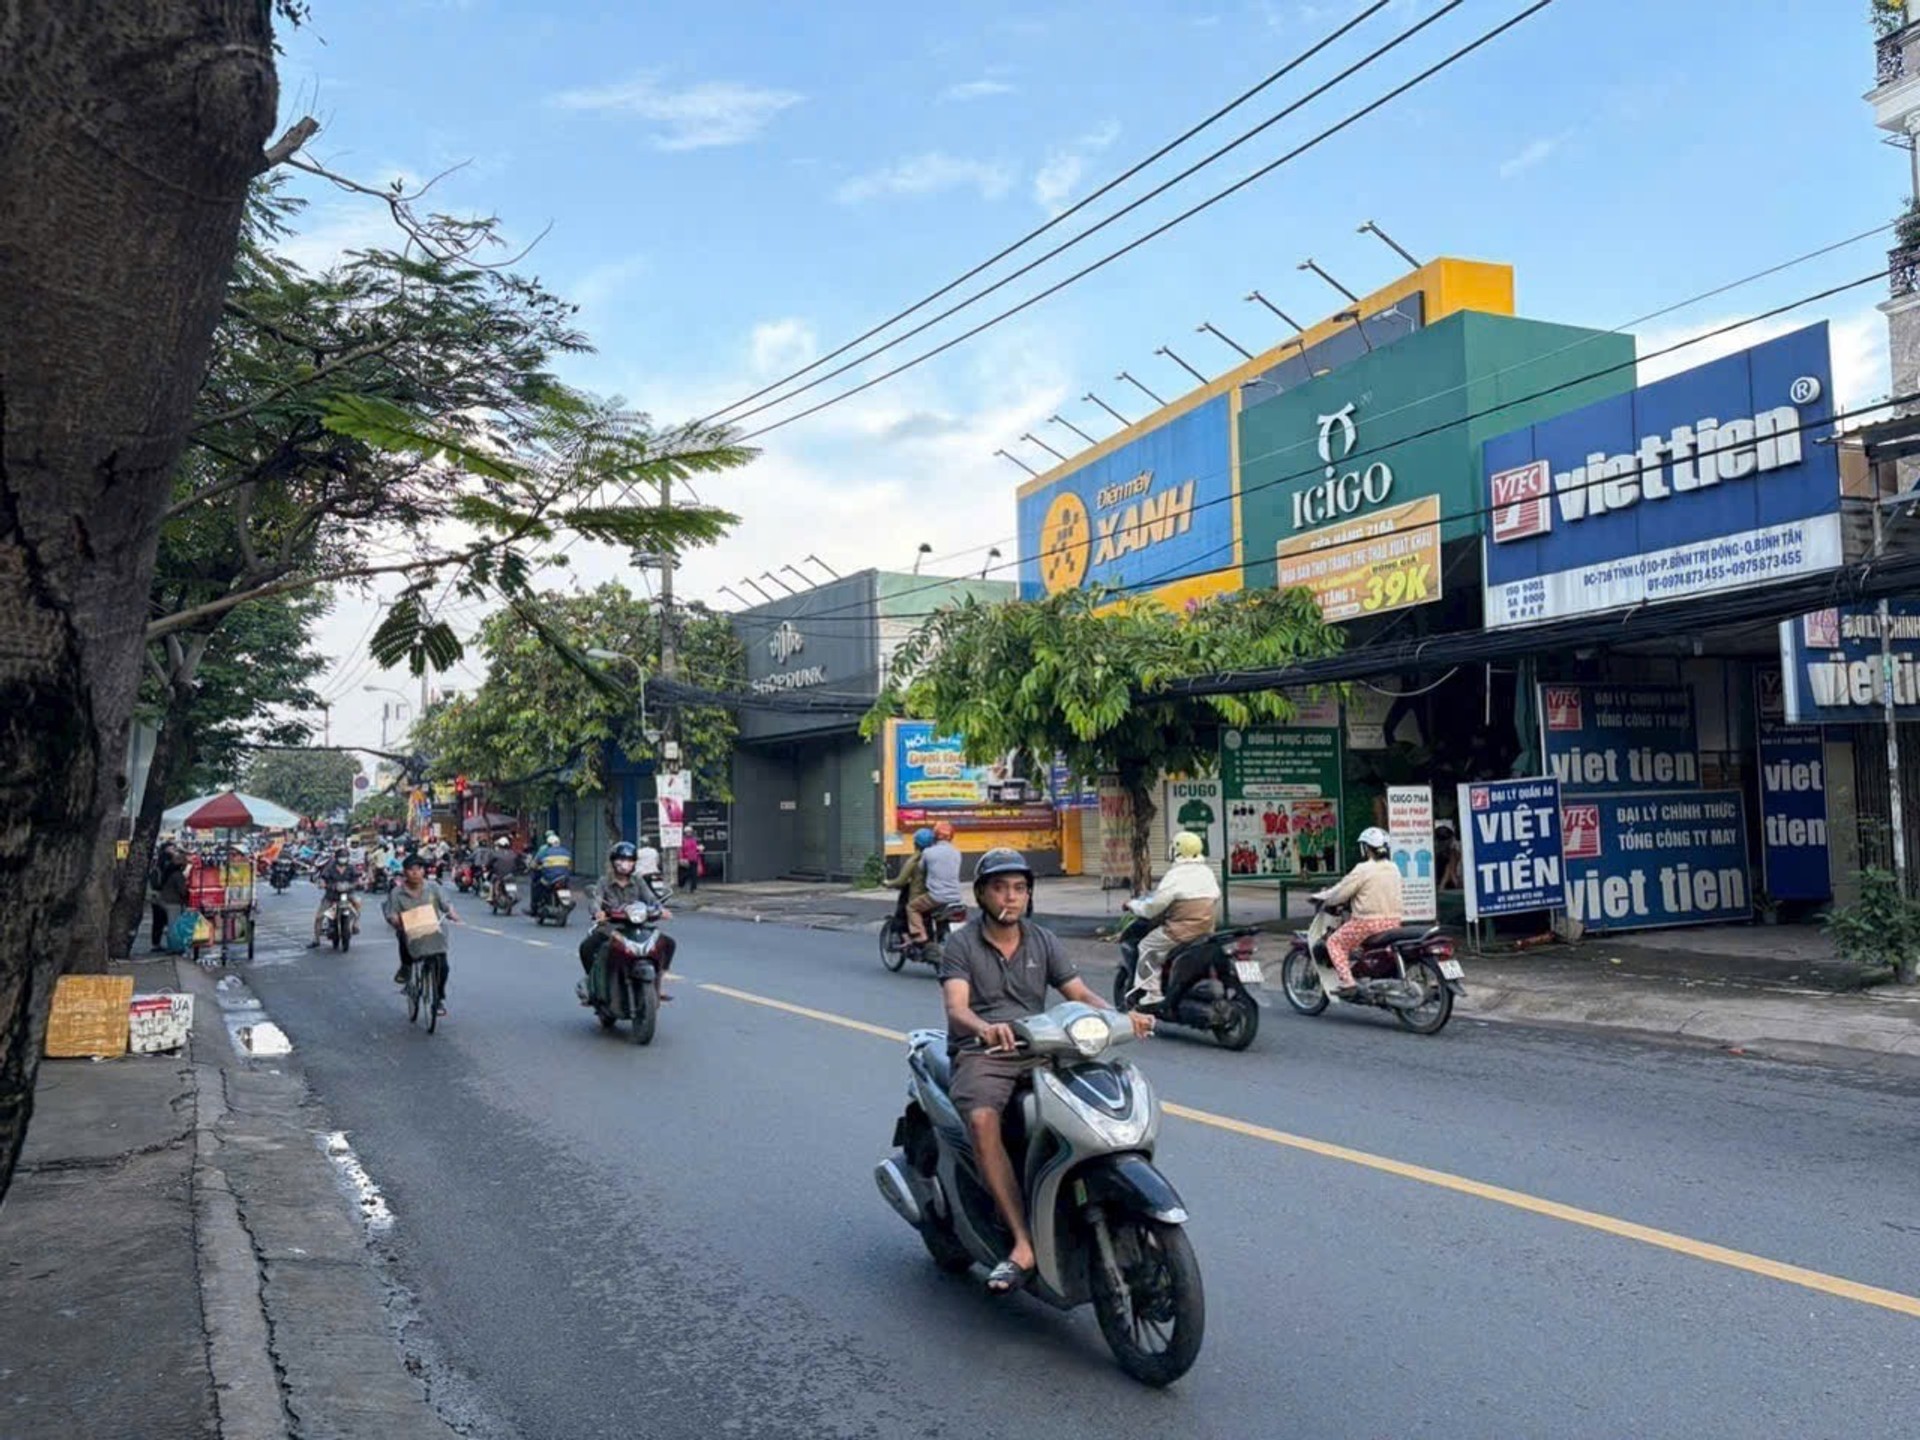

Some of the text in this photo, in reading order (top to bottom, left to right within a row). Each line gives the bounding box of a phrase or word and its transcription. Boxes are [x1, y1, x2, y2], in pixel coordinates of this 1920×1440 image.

[1494, 465, 1540, 498] VTEC
[1094, 480, 1196, 566] XANH
[1363, 564, 1431, 610] 39K
[1550, 747, 1696, 783] viet tien
[1764, 759, 1823, 791] viet
[1173, 783, 1217, 798] ICUGO
[1477, 803, 1555, 847] VIỆT
[1617, 807, 1640, 827] ĐẠI
[1643, 803, 1659, 821] LÝ
[1661, 801, 1700, 820] CHÍNH
[1704, 801, 1736, 818] THỨC
[1766, 814, 1827, 846] tien
[1618, 828, 1736, 850] TỔNG CÔNG TY MAY
[1478, 848, 1560, 894] TIẾN
[1565, 863, 1745, 920] viet tien
